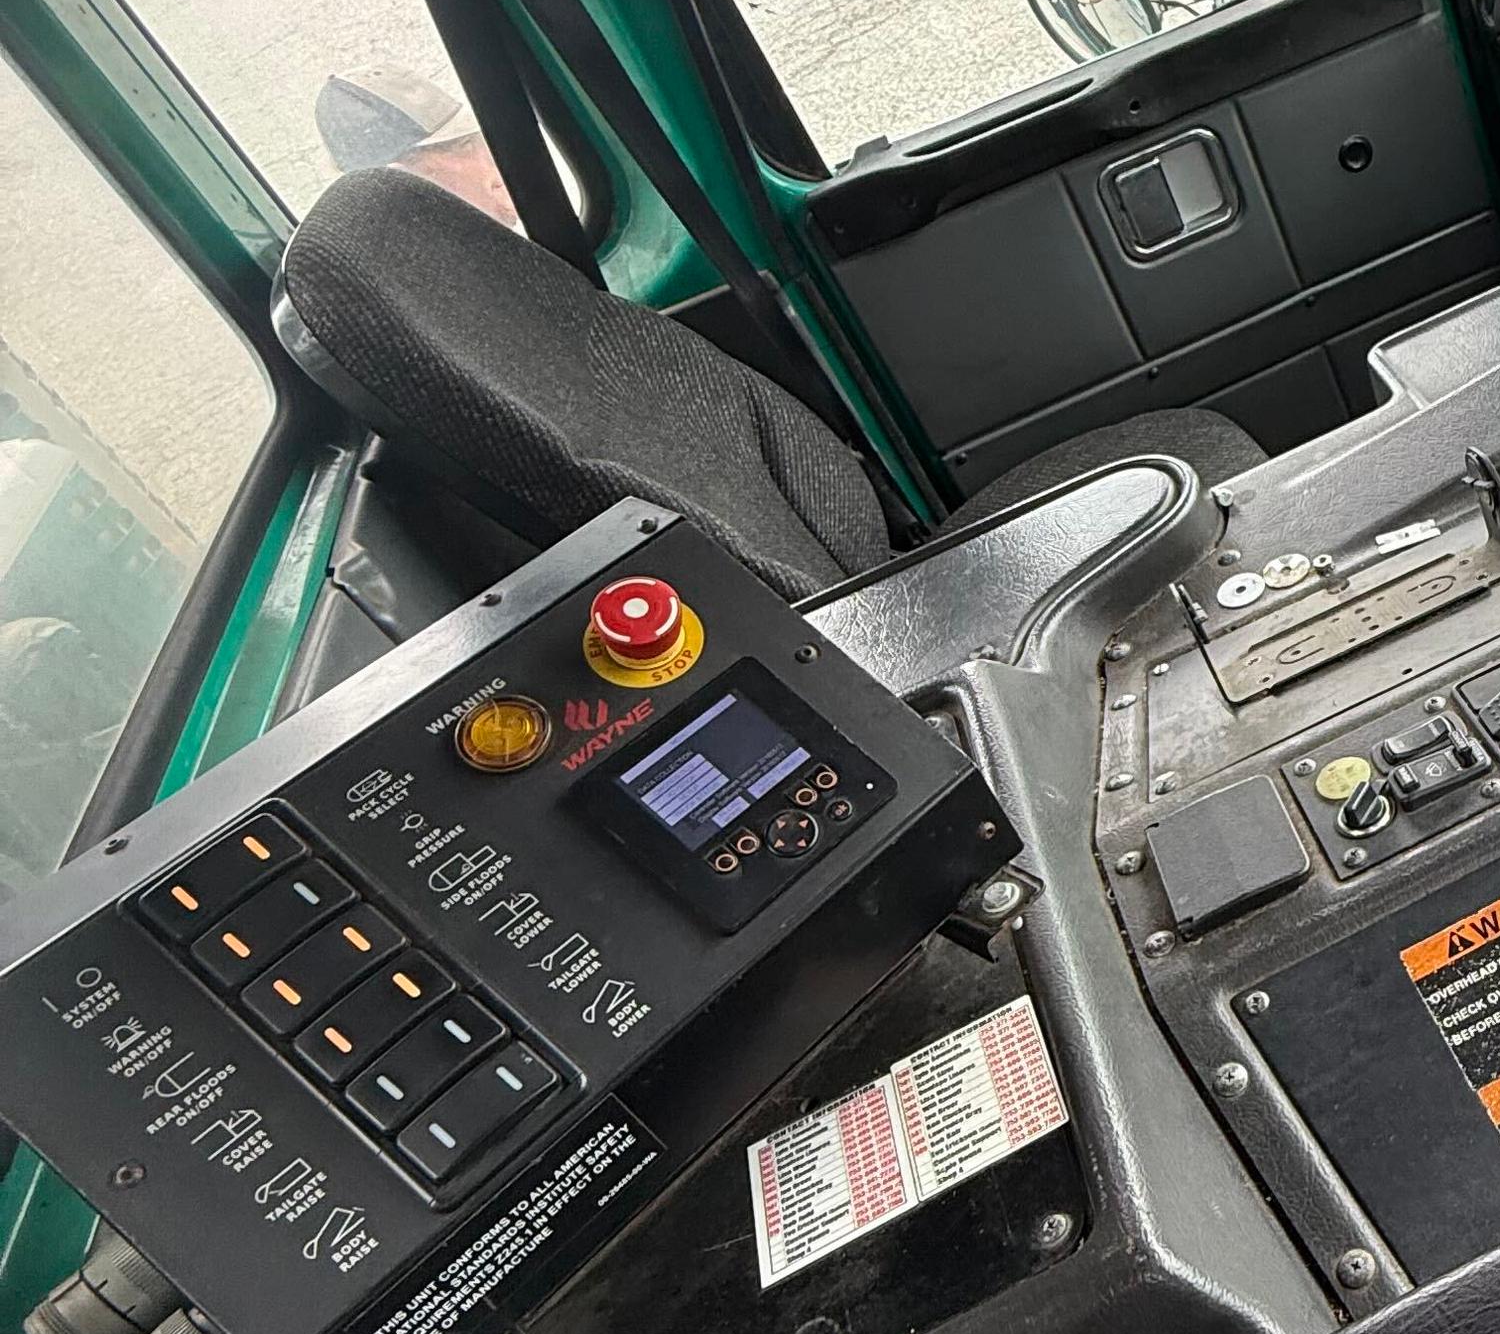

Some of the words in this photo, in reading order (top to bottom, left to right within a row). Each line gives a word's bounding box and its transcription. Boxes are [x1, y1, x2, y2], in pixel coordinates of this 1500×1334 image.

[651, 649, 692, 681] STOP
[424, 675, 508, 734] WARNING
[561, 698, 655, 771] WAYNE
[347, 796, 380, 822] PACK
[378, 771, 415, 801] CYCLE
[367, 786, 411, 821] SELECT
[406, 823, 466, 869] PRESSURE
[413, 826, 443, 851] GRIP
[439, 886, 469, 911] SIDE
[466, 853, 513, 890] FLOODS
[462, 872, 507, 907] ON/OFF
[505, 909, 545, 941] COVER
[511, 915, 555, 949] LOWER
[545, 947, 602, 991] TAILGATE
[561, 959, 604, 993] LOWER
[1425, 959, 1500, 1007] OVERHEAD
[61, 979, 116, 1024] SYSTEM
[71, 988, 124, 1031] ON/OFF
[605, 998, 640, 1027] BODY
[609, 1003, 654, 1038] LOWER
[1439, 996, 1490, 1030] CHECK
[107, 1023, 173, 1076] WARNING
[122, 1037, 175, 1079] ON/OFF
[145, 1102, 185, 1135] REAR
[182, 1062, 237, 1106] FLOODS
[174, 1085, 227, 1128] ON/OFF
[220, 1127, 268, 1167] COVER
[231, 1137, 275, 1173] RAISE
[262, 1169, 330, 1224] TAILGATE
[283, 1187, 327, 1223] RAISE
[404, 1278, 441, 1313] UNIT
[435, 1213, 513, 1285] CONFORMS
[507, 1196, 531, 1219] TO
[526, 1175, 555, 1203] ALL
[550, 1120, 616, 1180] AMERICAN
[447, 1216, 528, 1290] STANDARDS
[522, 1161, 588, 1221] INSTITUTE
[583, 1121, 632, 1167] SAFETY
[492, 1226, 535, 1266] Z245.1
[531, 1212, 550, 1230] IN
[545, 1171, 595, 1217] EFFECT
[590, 1153, 614, 1176] ON
[609, 1132, 638, 1159] THE
[329, 1229, 370, 1264] BODY
[336, 1236, 381, 1273] RAISE
[438, 1307, 462, 1331] OF
[457, 1223, 555, 1312] MANUFACTURE
